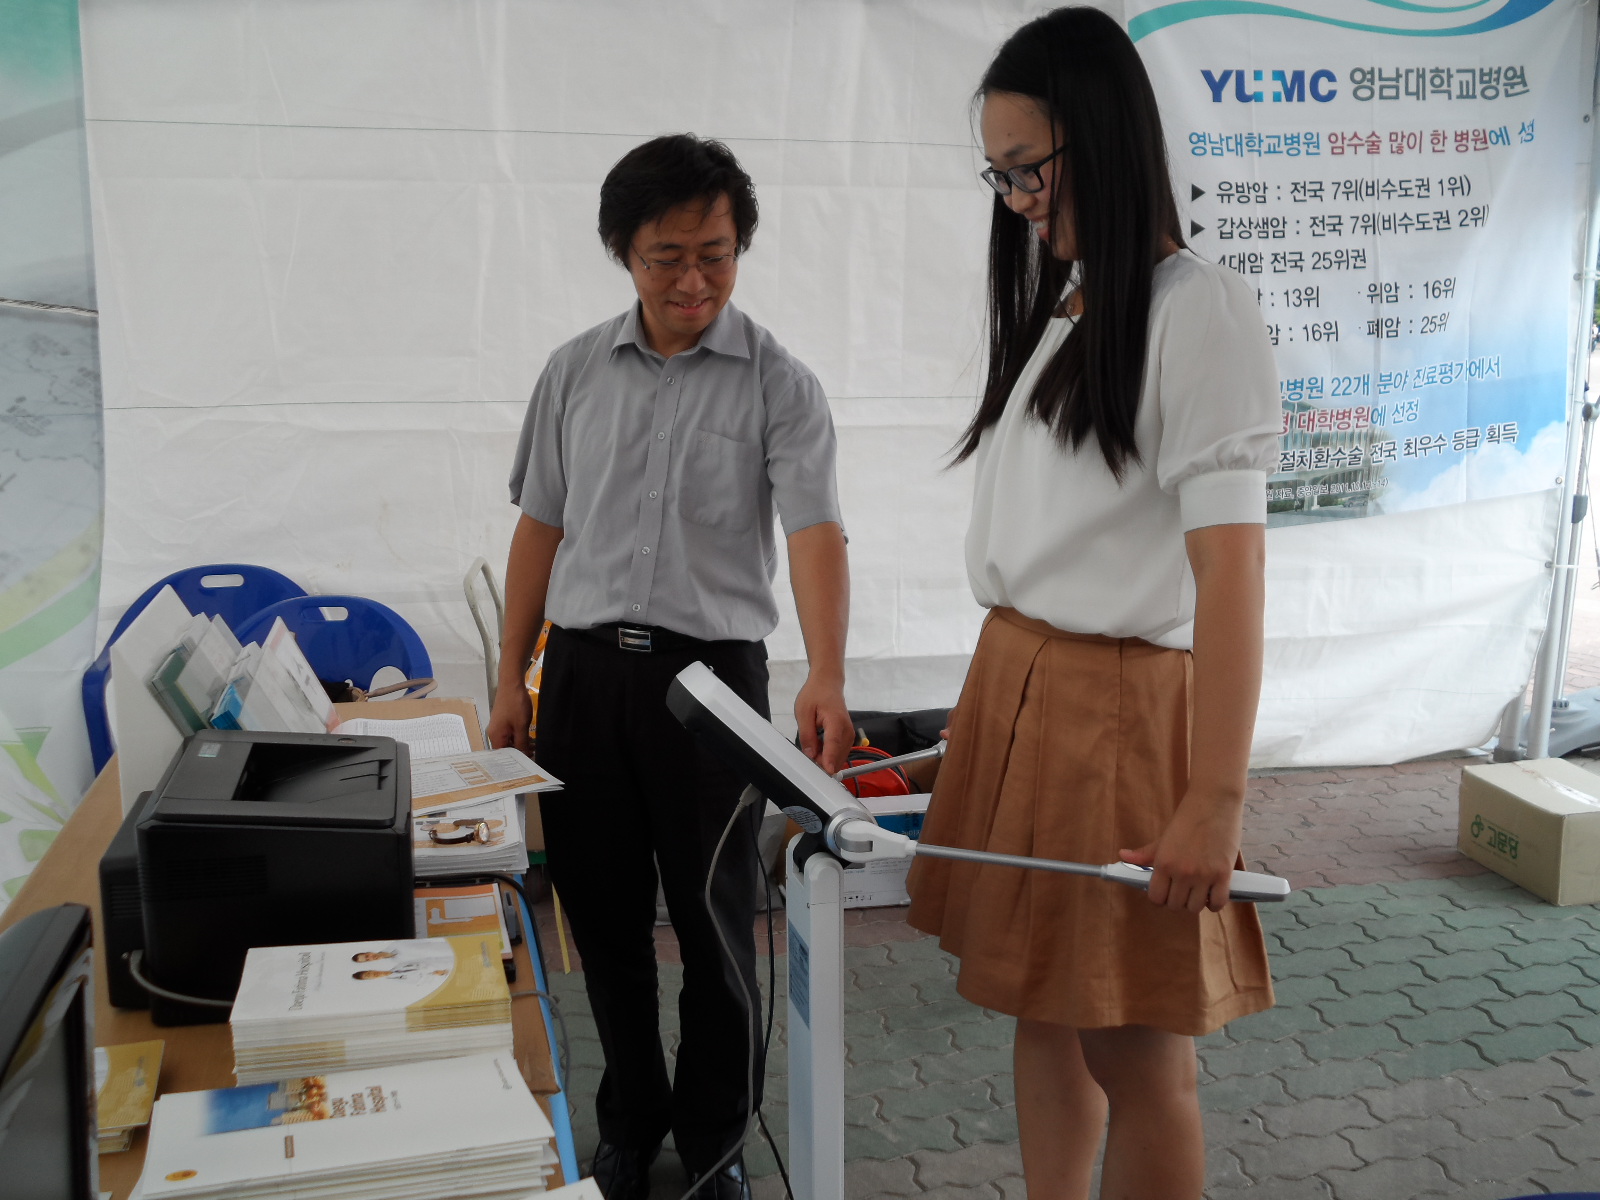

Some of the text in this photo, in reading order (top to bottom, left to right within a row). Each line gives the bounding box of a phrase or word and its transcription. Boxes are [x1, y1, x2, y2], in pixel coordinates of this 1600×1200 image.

[1349, 65, 1530, 101] 영남대학교병원
[1188, 131, 1321, 157] 영남대학교병원
[1327, 130, 1382, 155] 암수술
[1388, 130, 1423, 155] 많이
[1429, 129, 1448, 153] 한
[1454, 125, 1511, 153] 병원에
[1216, 181, 1268, 204] 유방암
[1290, 180, 1325, 203] 전국
[1331, 176, 1431, 202] 7위(비수도권
[1437, 174, 1472, 197] 1위)
[1217, 216, 1287, 239] 갑상샘암
[1309, 214, 1343, 237] 전국
[1350, 210, 1452, 236] 7위(비수도권
[1457, 203, 1490, 228] 2위)
[1270, 251, 1305, 274] 전국
[1311, 248, 1367, 272] 25위권
[1283, 286, 1320, 308] 13위
[1366, 281, 1400, 304] 위암
[1423, 276, 1457, 300] 16위
[1302, 320, 1339, 343] 16위
[1366, 316, 1402, 339] 폐암
[1420, 311, 1450, 335] 25위
[1331, 373, 1371, 397] 22개
[1376, 369, 1410, 395] 분야
[1412, 355, 1501, 390] 진료평가에서
[1297, 404, 1387, 433] 대학병원에
[1391, 398, 1420, 424] 선정
[1276, 421, 1518, 472] 절치환수술 전국 최우수 등급 획득
